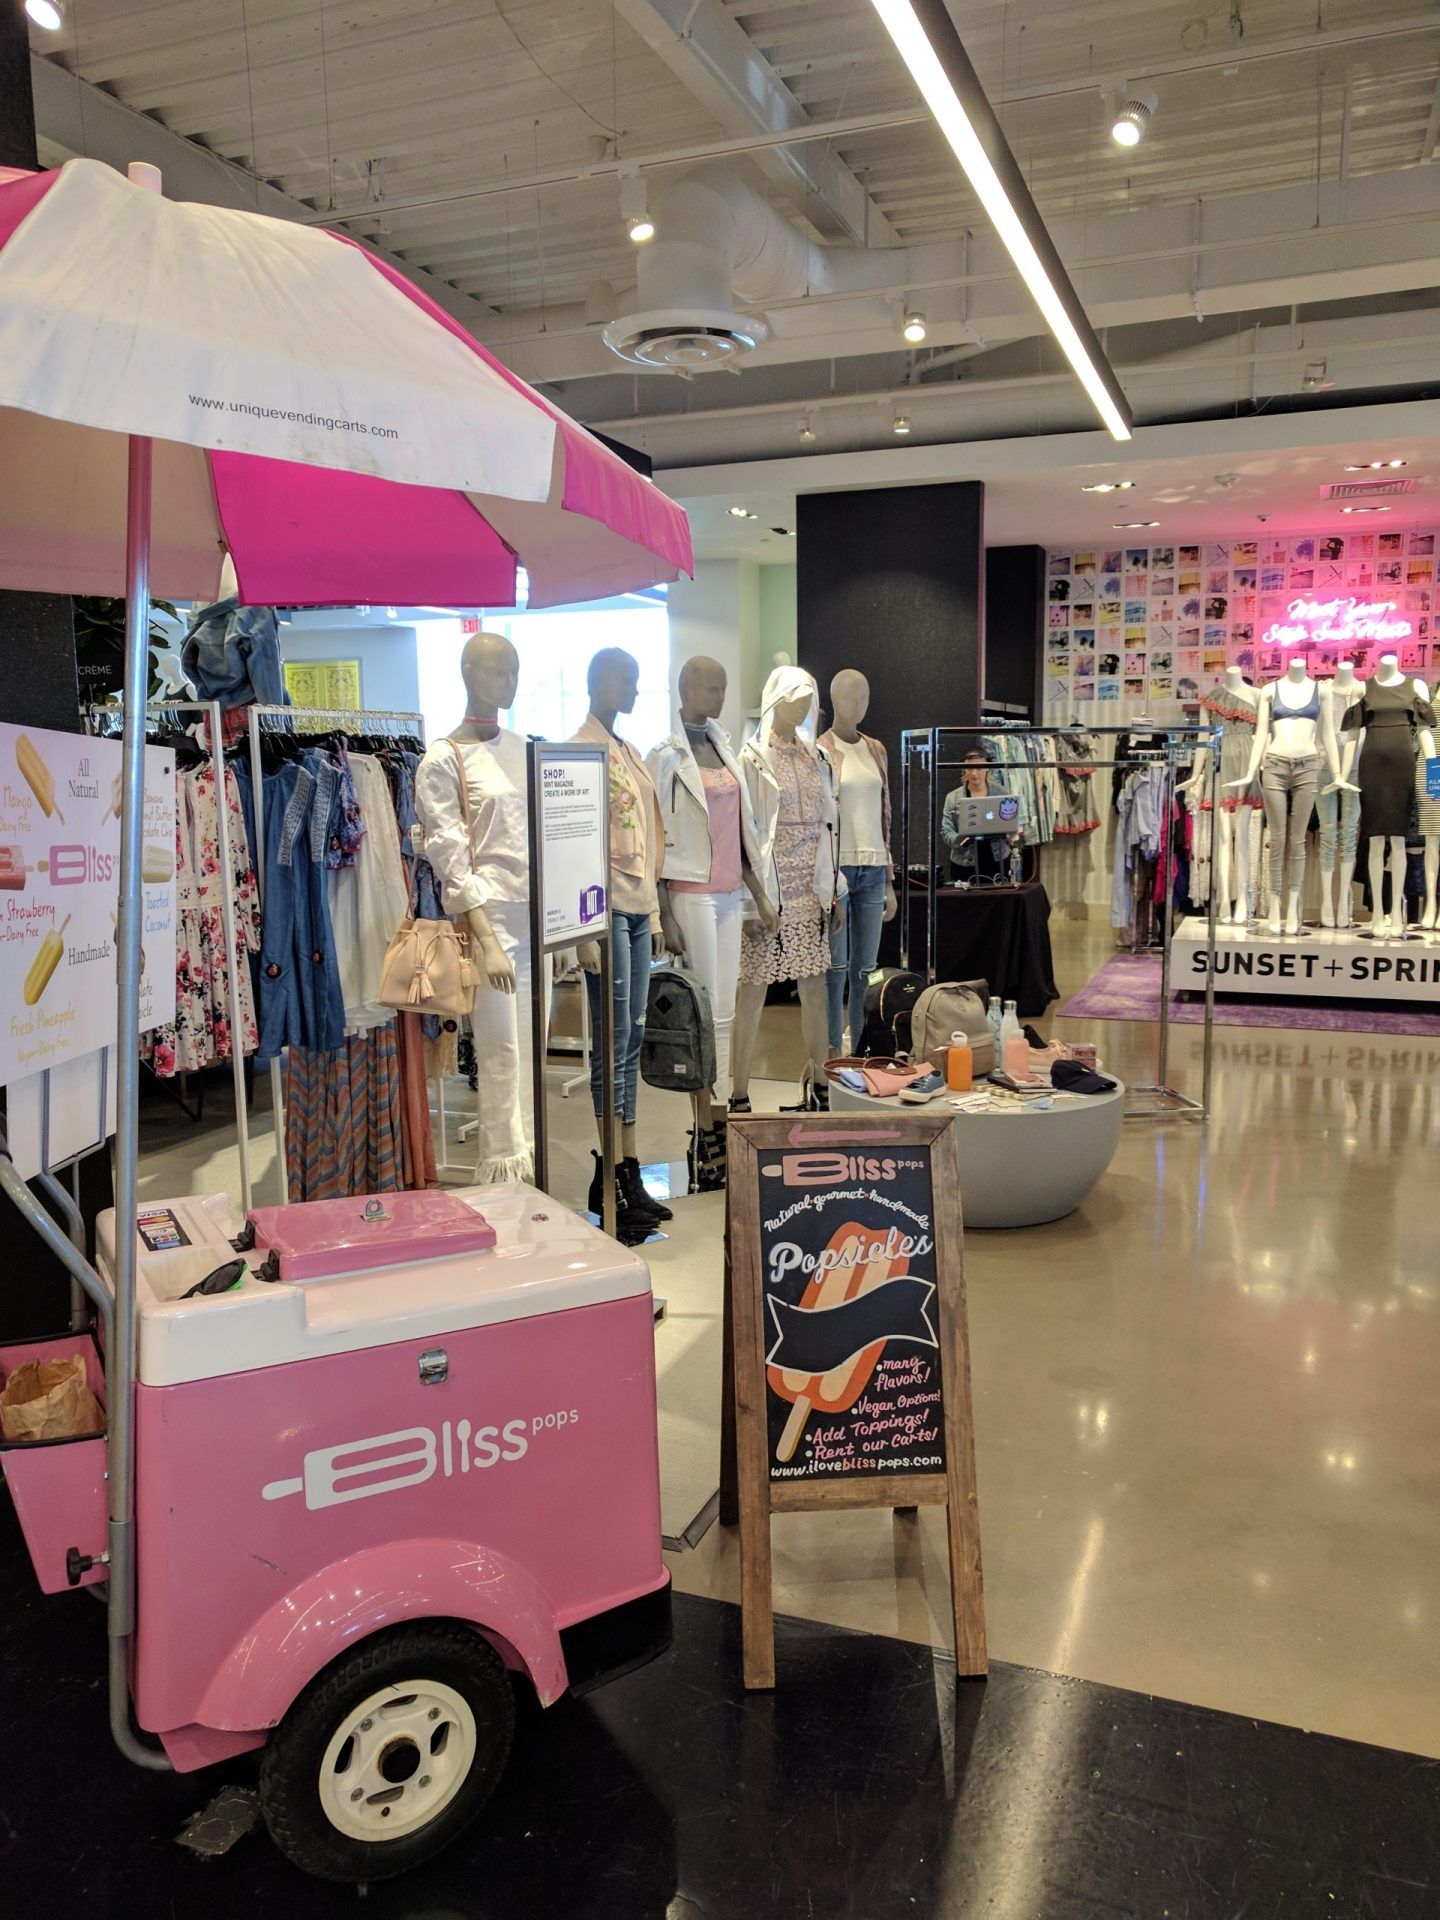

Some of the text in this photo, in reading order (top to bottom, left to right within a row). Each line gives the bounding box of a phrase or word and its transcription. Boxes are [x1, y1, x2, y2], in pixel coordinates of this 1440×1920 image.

[188, 394, 399, 439] www.uniquevendingcarts.com
[77, 758, 90, 777] All
[544, 769, 565, 779] SHOP!
[68, 779, 100, 799] Natural
[50, 843, 112, 886] Bliss
[7, 896, 55, 926] Strawberry
[26, 922, 39, 937] Free
[68, 940, 111, 966] Handmade
[783, 1153, 925, 1187] Bliss pops
[883, 1355, 926, 1374] many
[874, 1367, 931, 1392] flavors!
[858, 1389, 941, 1419] Vegan Options!
[813, 1408, 930, 1446] Add Toppings!
[304, 1409, 579, 1511] Bliss pops
[815, 1442, 855, 1460] Rent
[862, 1440, 889, 1452] our
